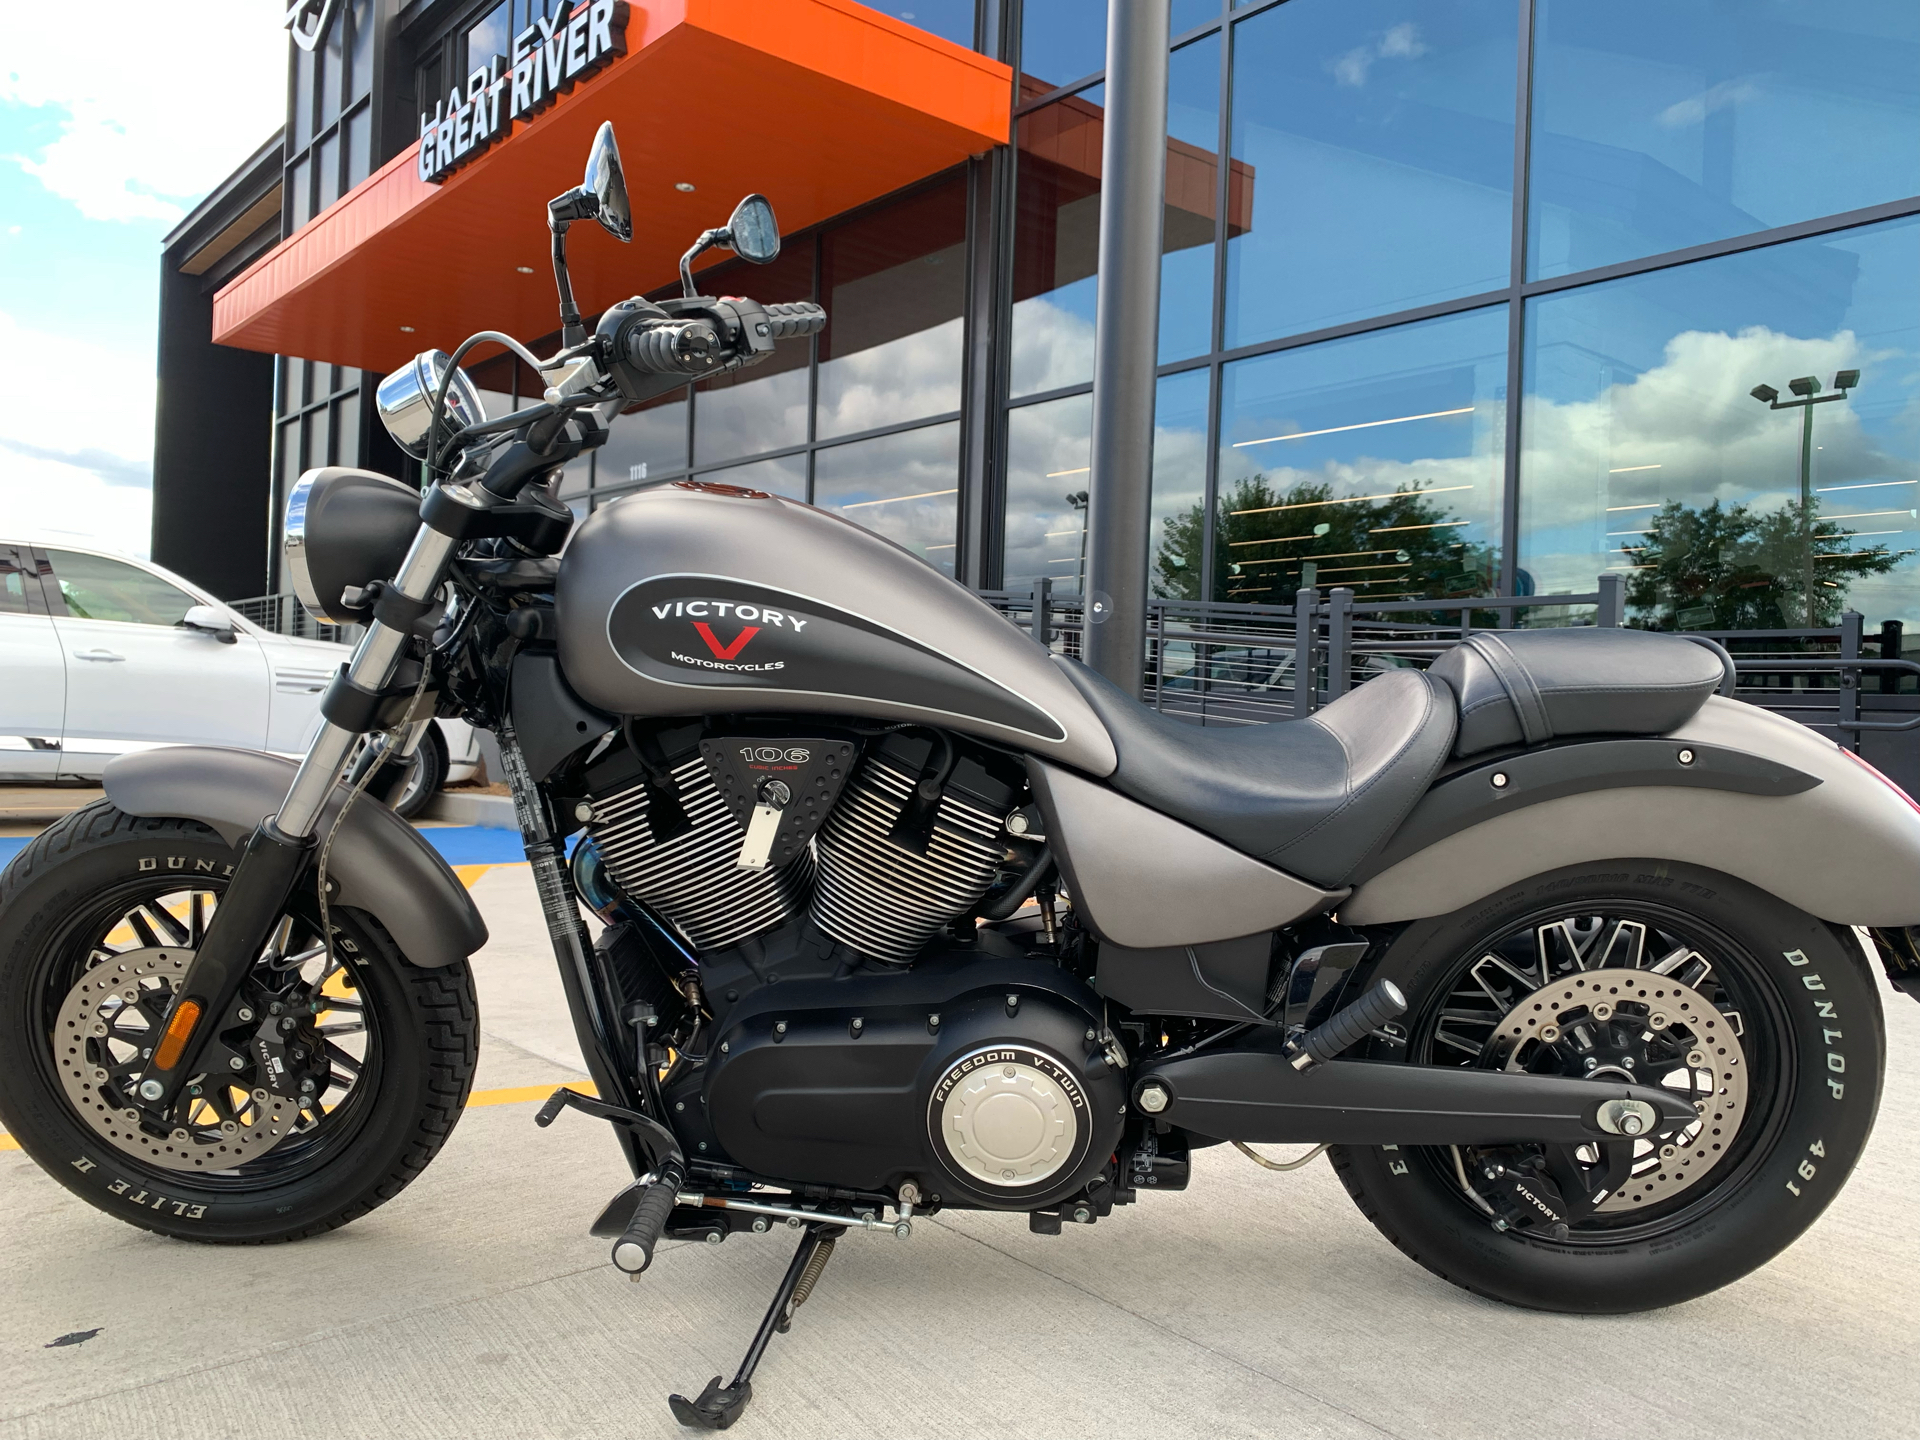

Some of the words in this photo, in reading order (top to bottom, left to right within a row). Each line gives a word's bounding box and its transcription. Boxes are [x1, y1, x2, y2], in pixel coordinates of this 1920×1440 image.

[418, 76, 505, 182] GREAT
[510, 0, 615, 119] RIVER
[630, 462, 647, 481] 1116
[651, 601, 808, 633] VICTORY
[671, 651, 785, 671] MOTORCYCLES
[739, 747, 810, 763] 106
[1783, 948, 1846, 1100] DUNLOP
[258, 1041, 279, 1089] VICTORY
[936, 1051, 1016, 1102] FREEDOM
[1033, 1056, 1084, 1108] V-TWIN
[71, 1156, 97, 1174] II
[1786, 1139, 1826, 1197] 491
[107, 1179, 208, 1219] ELITE
[1516, 1183, 1560, 1222] VICTORY
